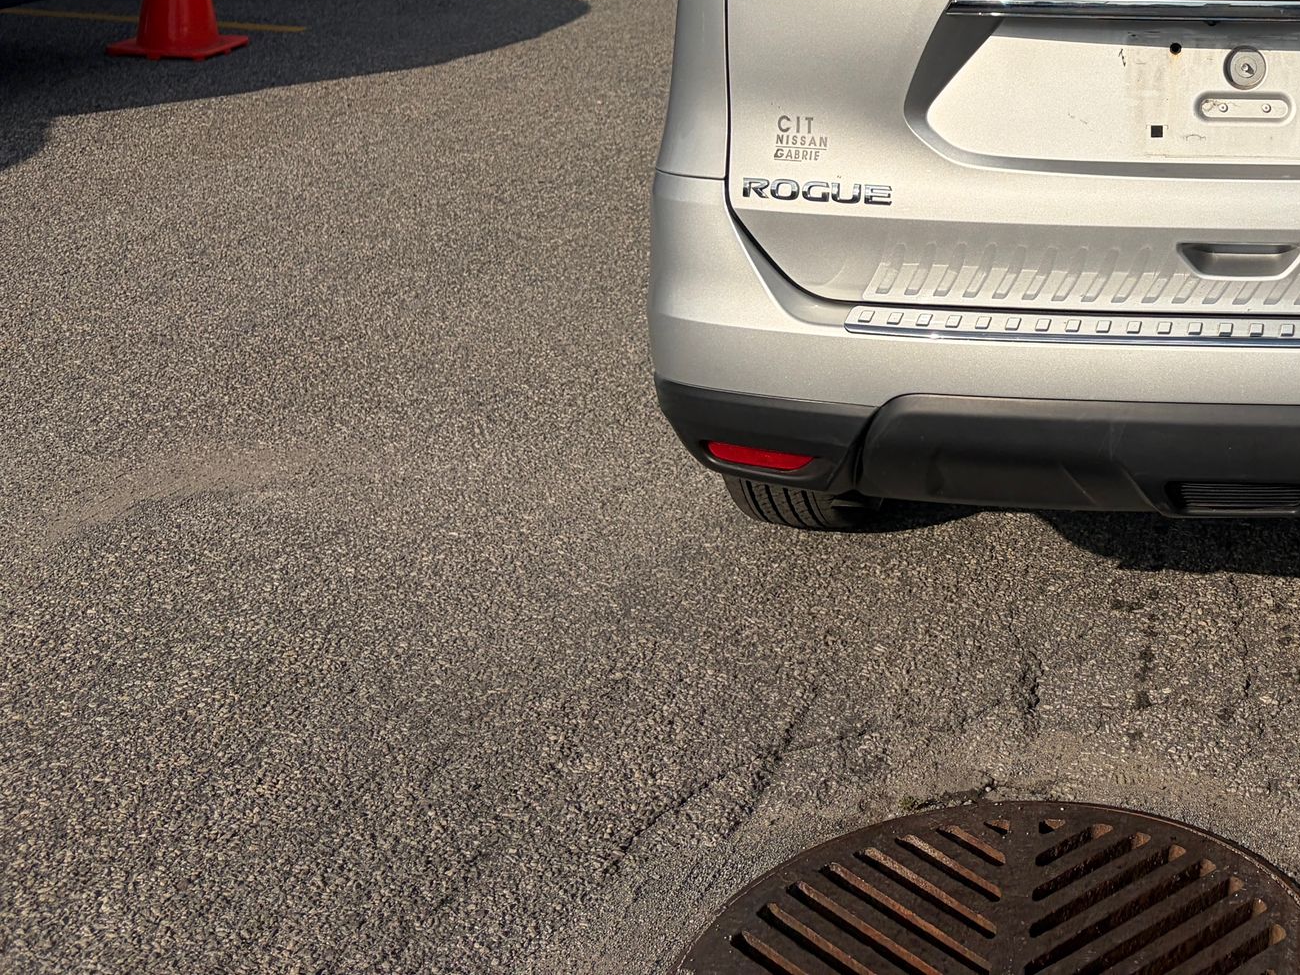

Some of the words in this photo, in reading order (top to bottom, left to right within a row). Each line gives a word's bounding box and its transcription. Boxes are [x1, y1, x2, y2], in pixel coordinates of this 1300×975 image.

[777, 115, 814, 134] CIT
[775, 134, 828, 147] NISSAN
[773, 148, 820, 161] GABRIE
[742, 177, 892, 206] ROGUE
